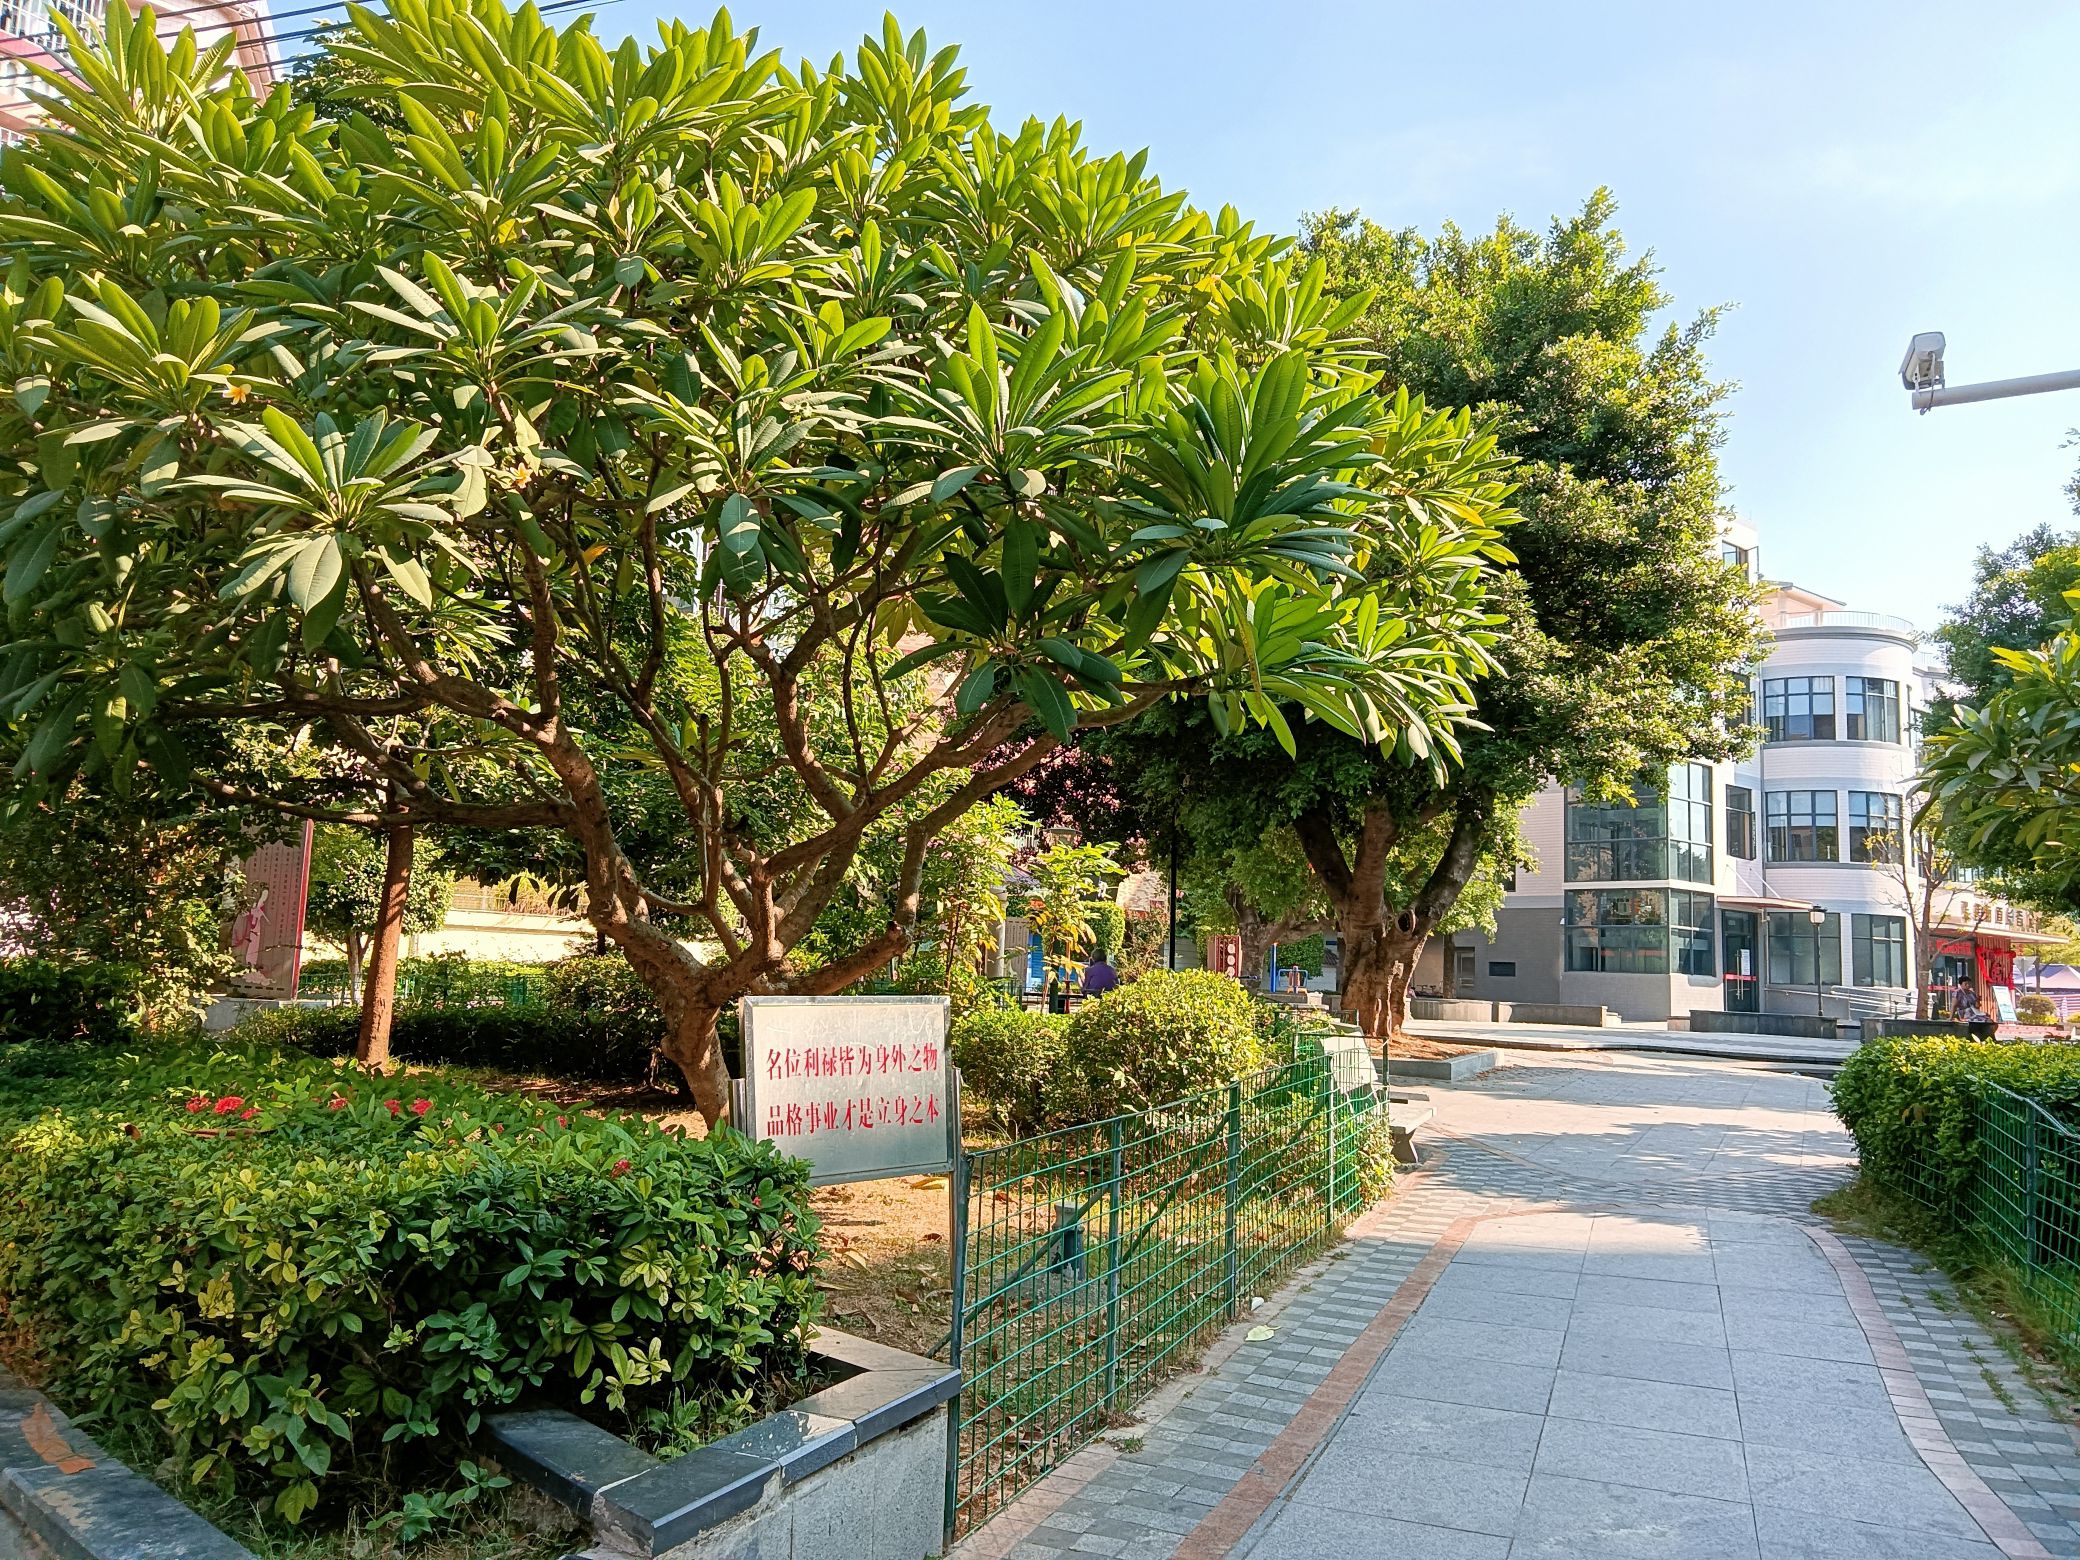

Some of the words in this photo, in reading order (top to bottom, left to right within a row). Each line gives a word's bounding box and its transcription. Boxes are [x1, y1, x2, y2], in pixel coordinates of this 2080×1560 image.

[767, 1043, 938, 1080] 名位利禄皆为身外之物
[767, 1094, 939, 1136] 品格事业才是立身之本
